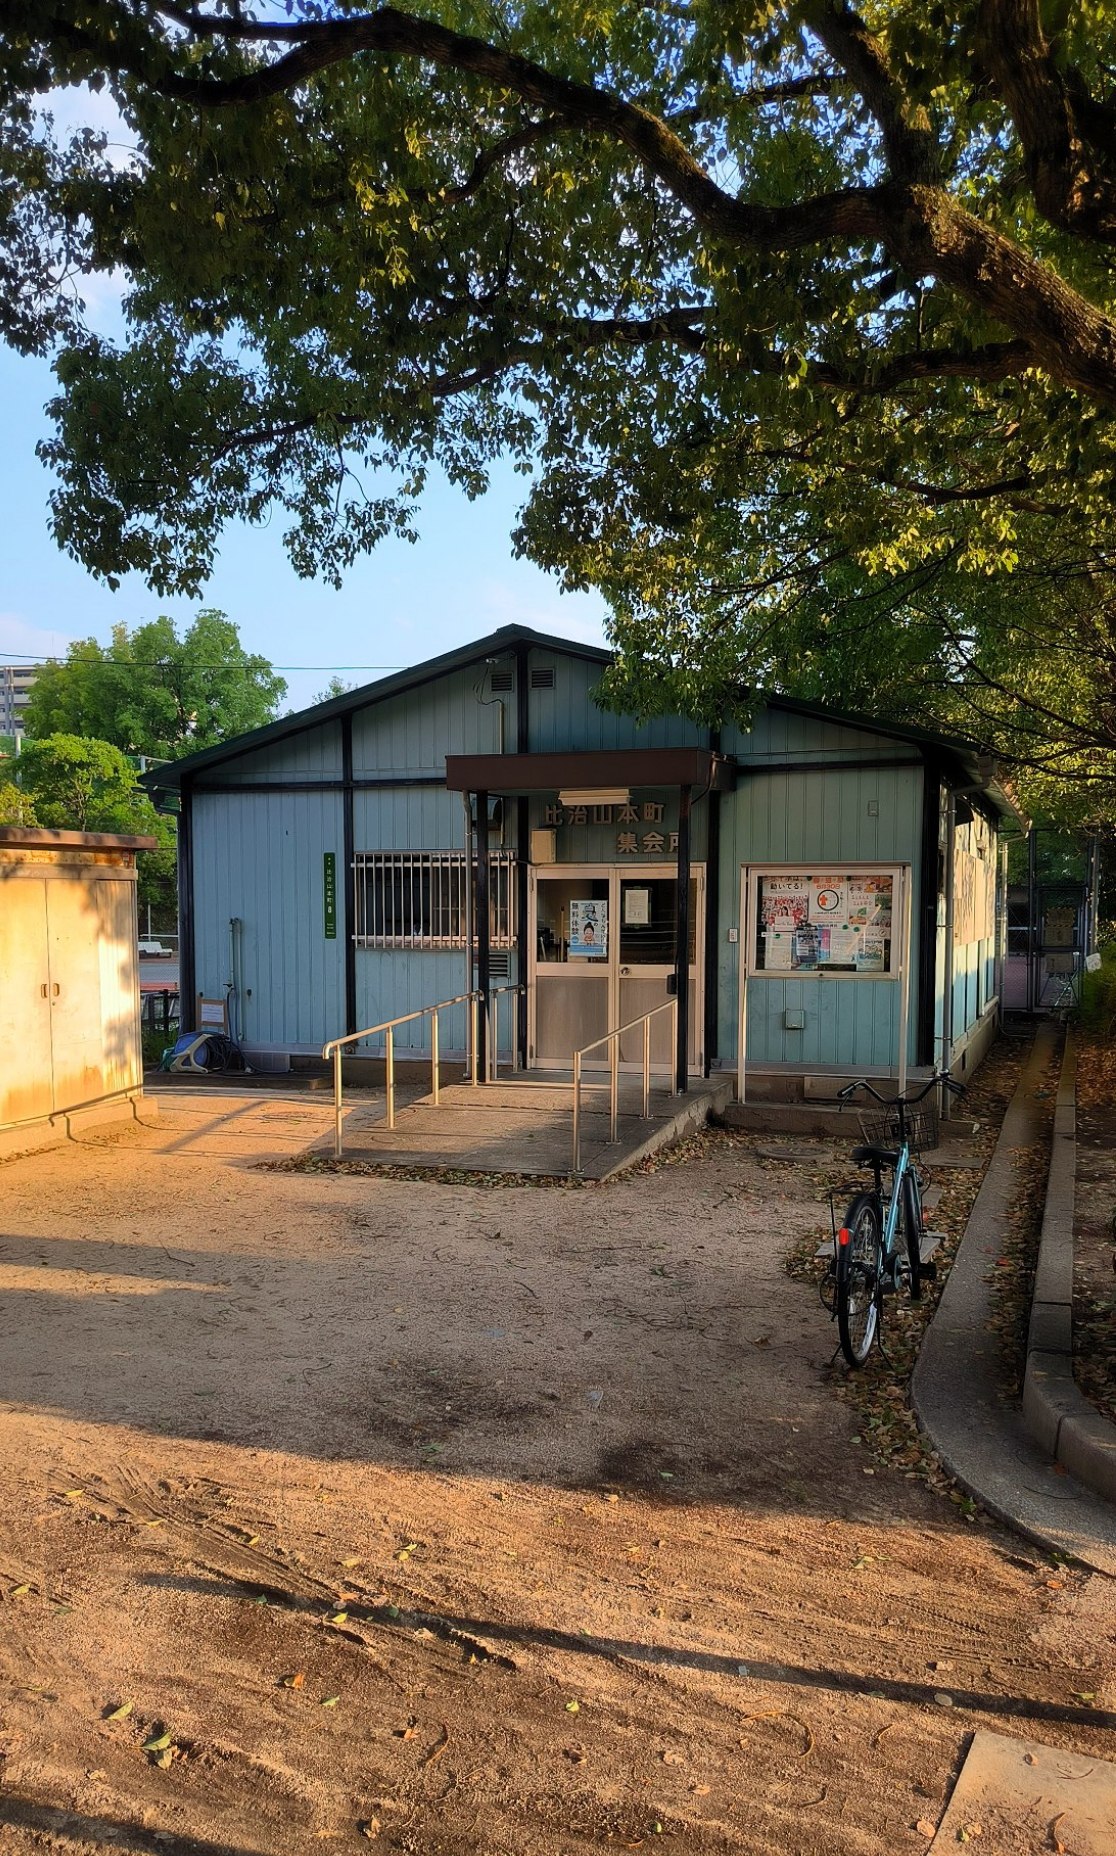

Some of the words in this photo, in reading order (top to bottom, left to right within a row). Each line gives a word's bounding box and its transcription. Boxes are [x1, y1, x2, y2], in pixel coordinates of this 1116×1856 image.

[545, 802, 664, 824] 比治山本町
